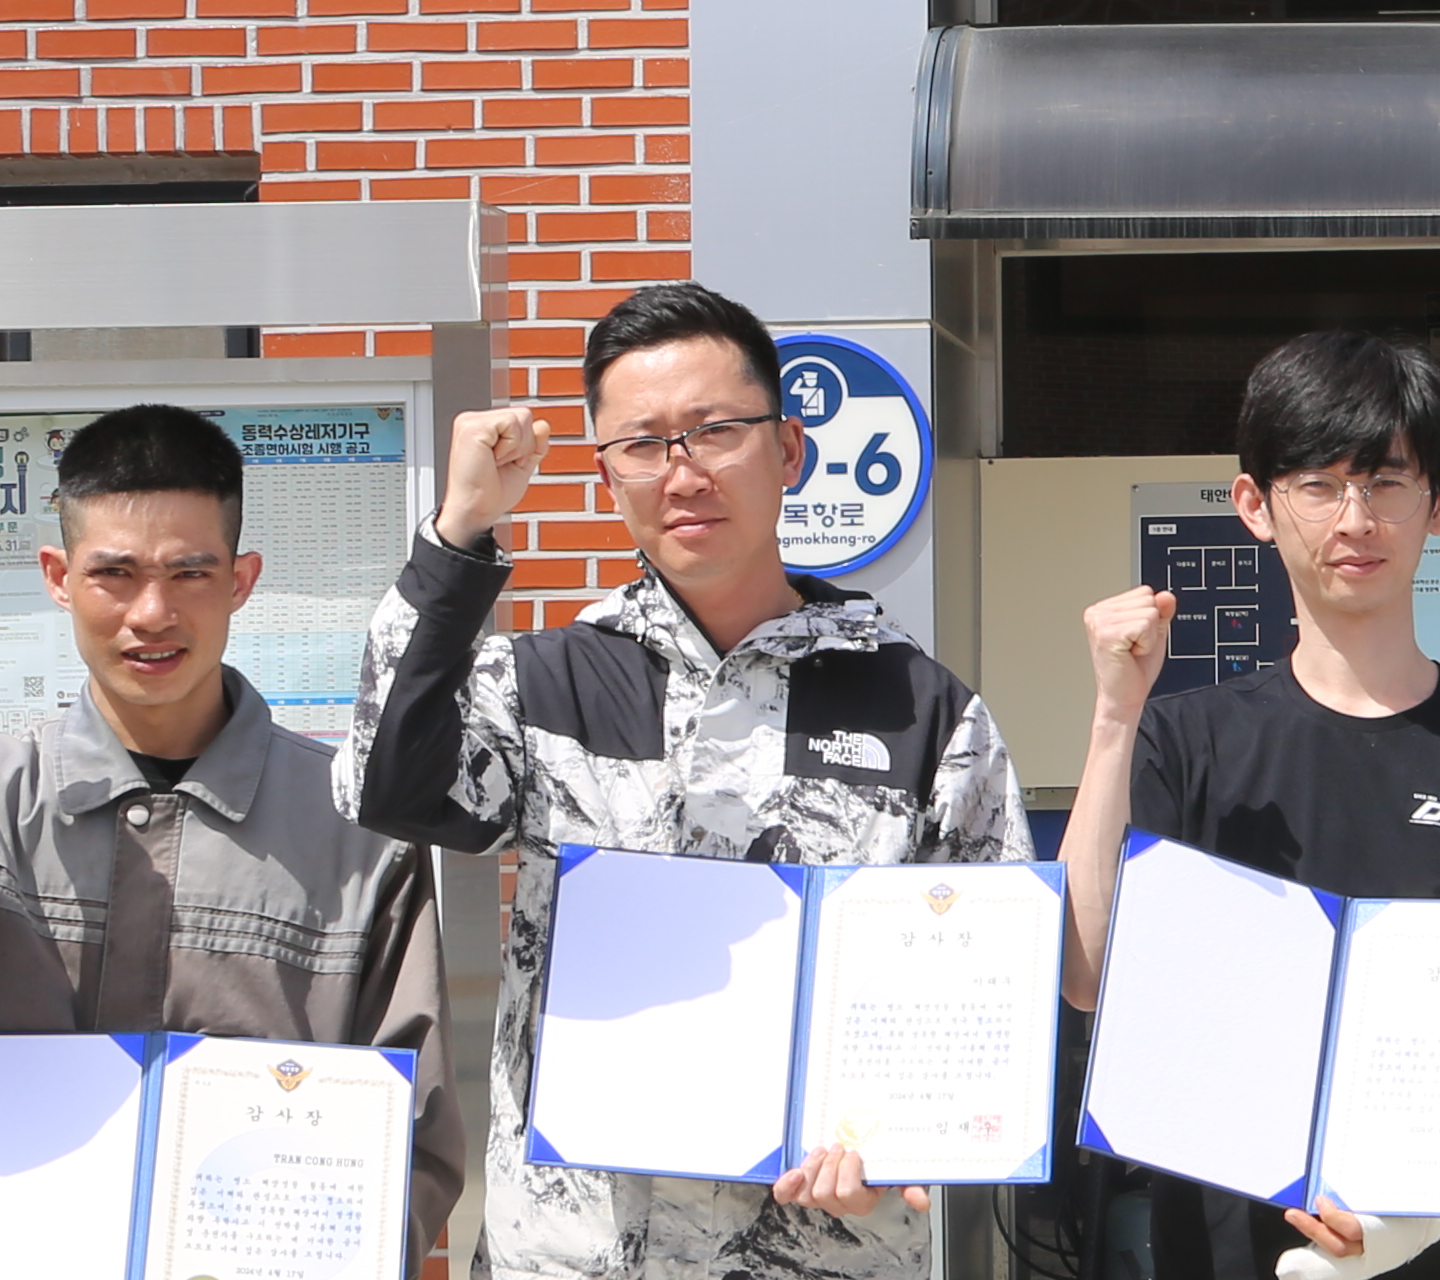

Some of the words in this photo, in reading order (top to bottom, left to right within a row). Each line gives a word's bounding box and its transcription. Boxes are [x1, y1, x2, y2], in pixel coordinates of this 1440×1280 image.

[242, 423, 370, 441] 동력수상레저기구
[346, 442, 370, 454] 공고
[783, 503, 864, 528] 목항로
[807, 737, 862, 756] NORTH
[832, 730, 862, 746] THE
[822, 751, 862, 768] FACE
[273, 1154, 301, 1165] TRAN
[305, 1156, 332, 1167] CONG
[336, 1158, 364, 1168] HUNG
